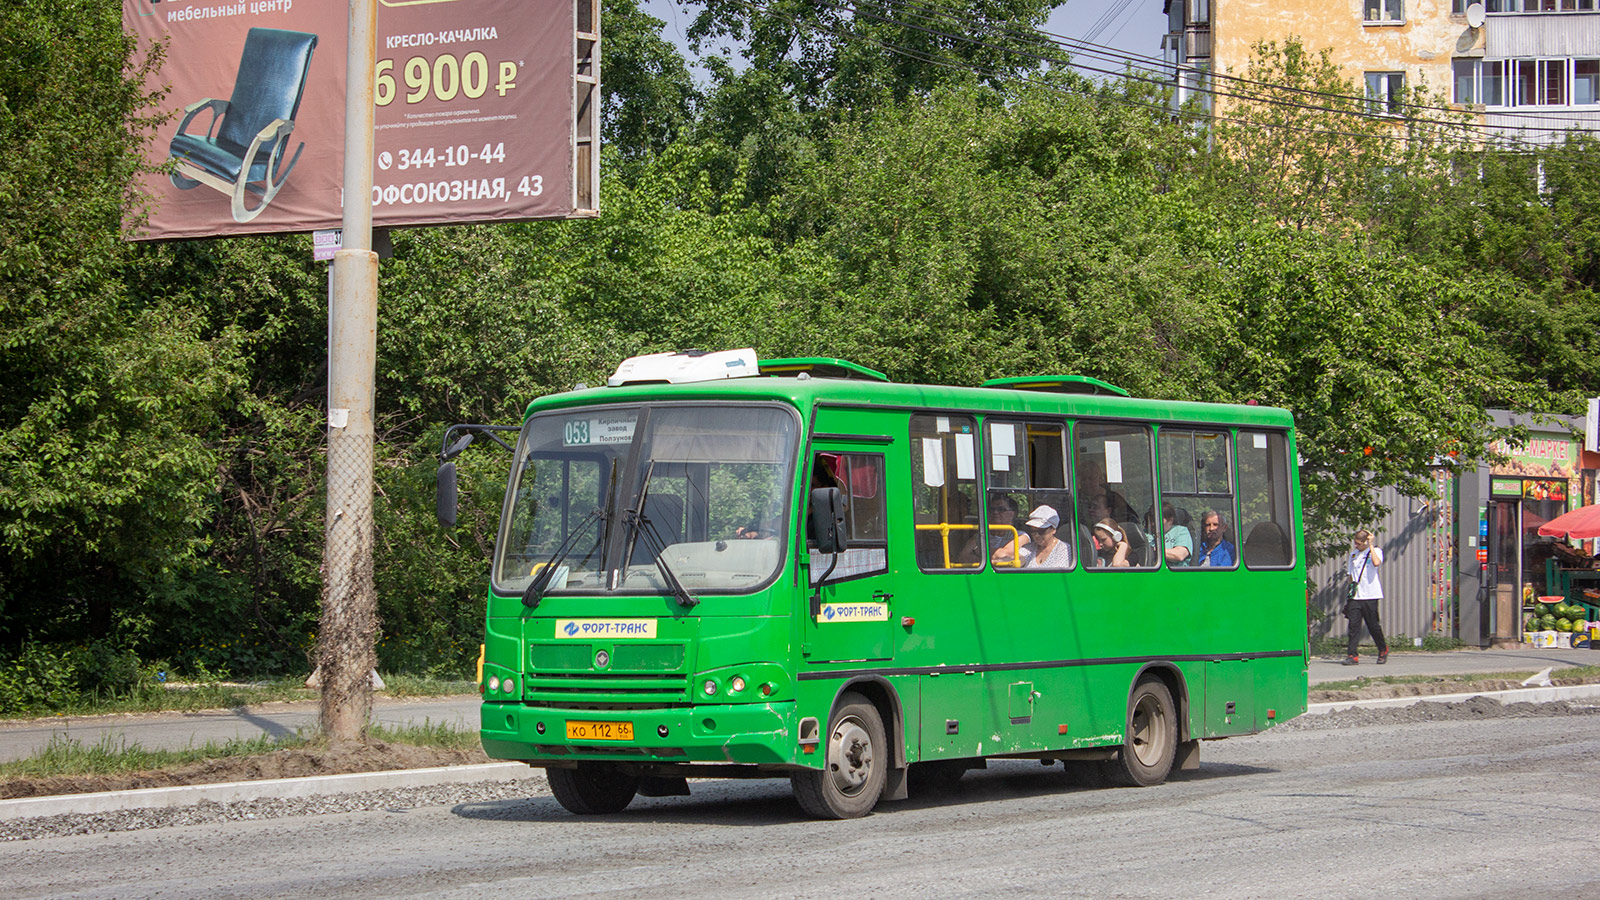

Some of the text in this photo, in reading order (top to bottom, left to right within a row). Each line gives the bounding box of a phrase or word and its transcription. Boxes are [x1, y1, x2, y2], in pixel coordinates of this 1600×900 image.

[167, 0, 292, 22] мебельный центр
[386, 26, 498, 48] КРЕСЛО-КАЧАЛКА
[404, 50, 489, 104] 900
[397, 142, 506, 170] 344-10-44
[341, 175, 544, 208] ОФСОЮЗНАЯ, 43
[565, 420, 588, 444] 053
[836, 606, 882, 617] ФОРТ-ТРАНС
[581, 622, 648, 634] ФОРТ-ТРАНС
[591, 723, 612, 738] 112
[617, 723, 629, 734] 66
